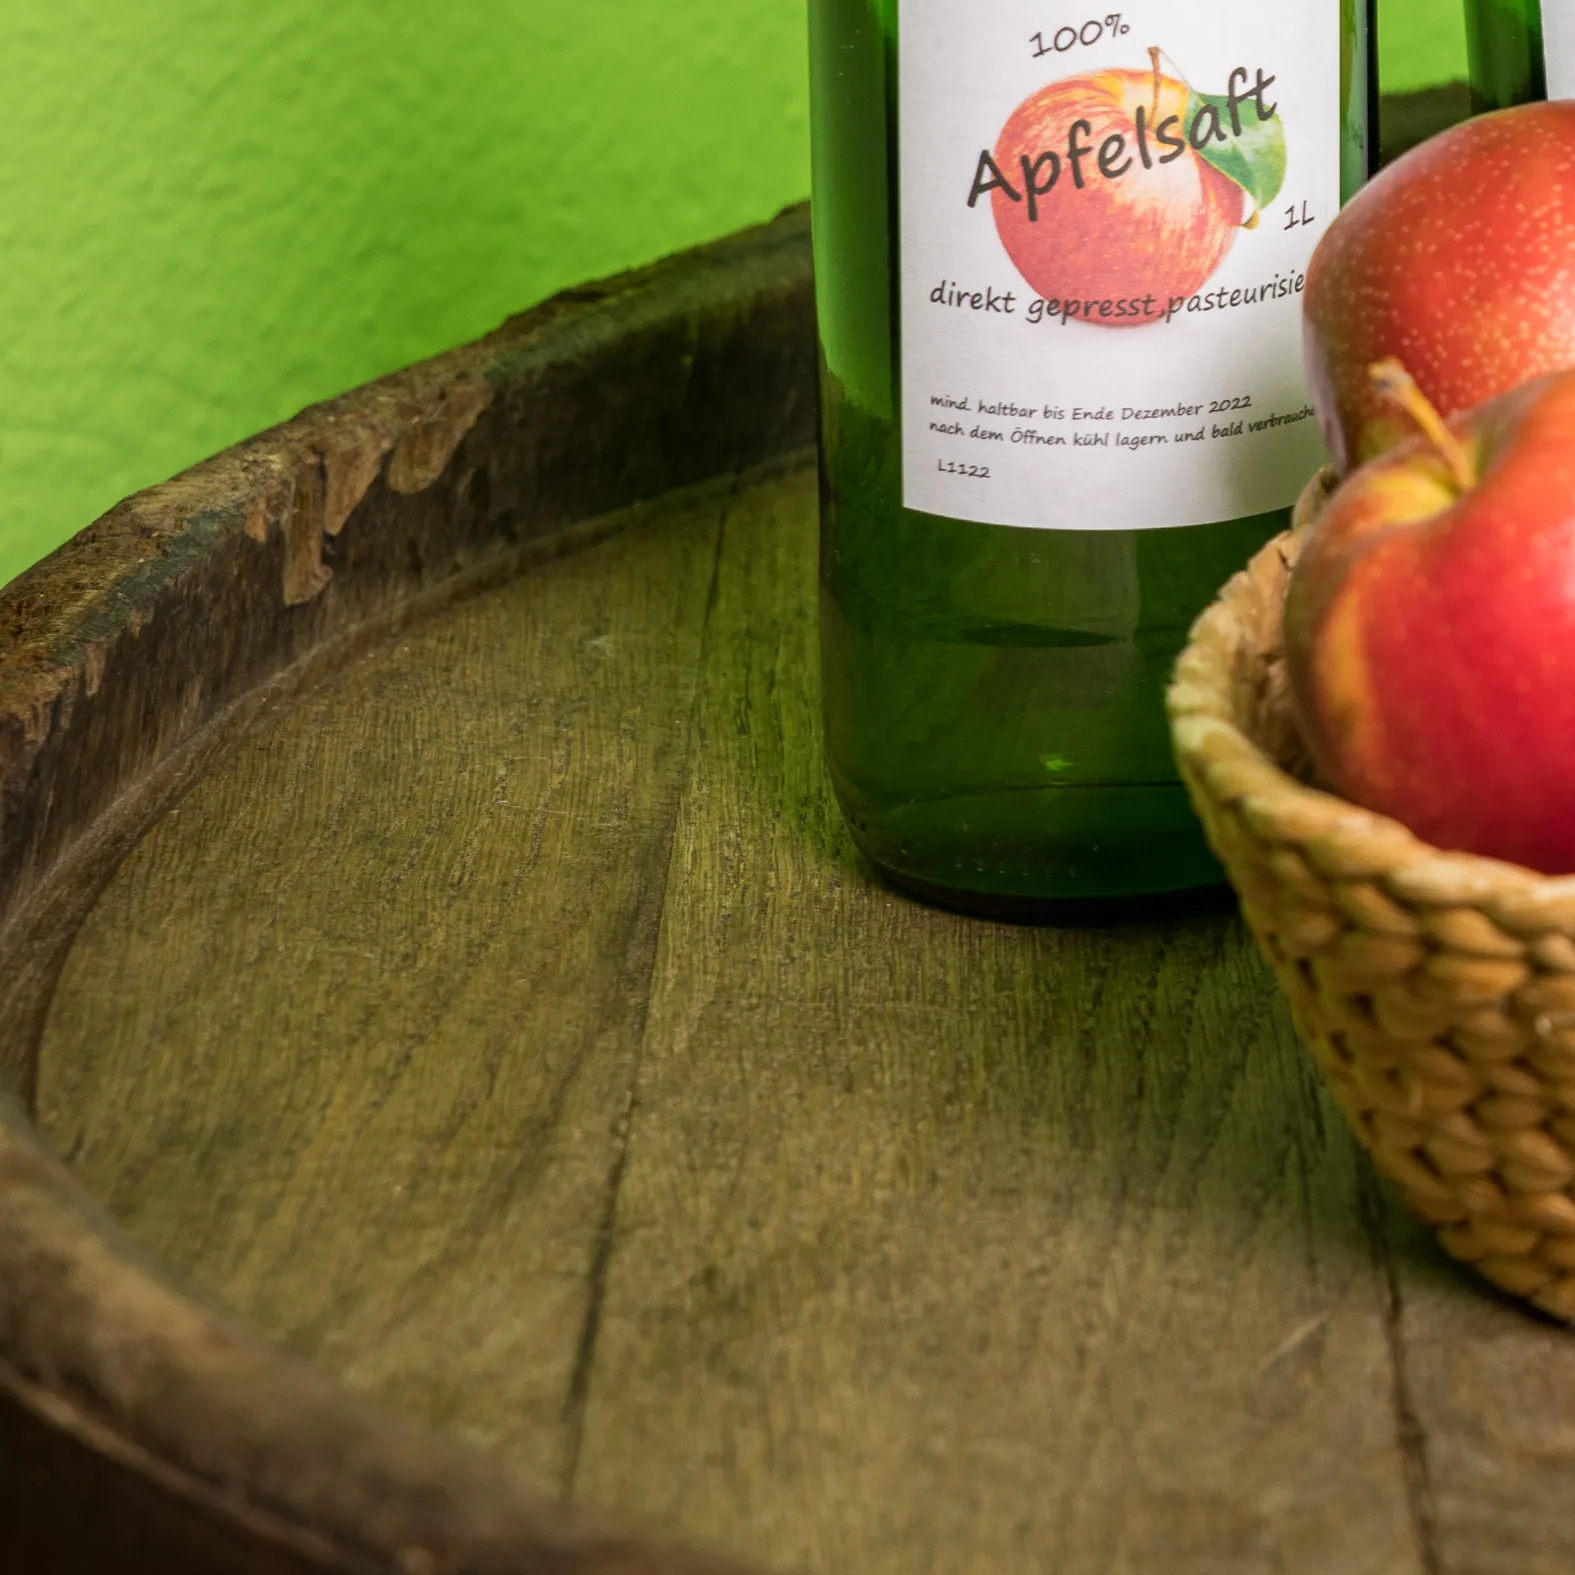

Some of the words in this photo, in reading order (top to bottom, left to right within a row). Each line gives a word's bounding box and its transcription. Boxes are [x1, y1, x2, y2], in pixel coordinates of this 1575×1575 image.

[1028, 13, 1131, 59] 100%
[967, 66, 1276, 222] Apfelsaft
[1283, 199, 1315, 231] 1L
[929, 279, 1017, 314] direkt
[977, 399, 1038, 418] haltbar
[1043, 404, 1065, 421] bis
[1071, 406, 1114, 421] Ende
[1121, 402, 1205, 421] Dezember
[1208, 395, 1253, 414] 2022
[929, 422, 965, 436] nach
[968, 424, 1004, 442] dem
[1010, 426, 1067, 446] Öffnen
[1073, 432, 1110, 447] kühl
[1115, 432, 1169, 451] lagern
[1174, 425, 1206, 443] und
[1211, 419, 1244, 439] bald
[937, 459, 991, 479] L1122
